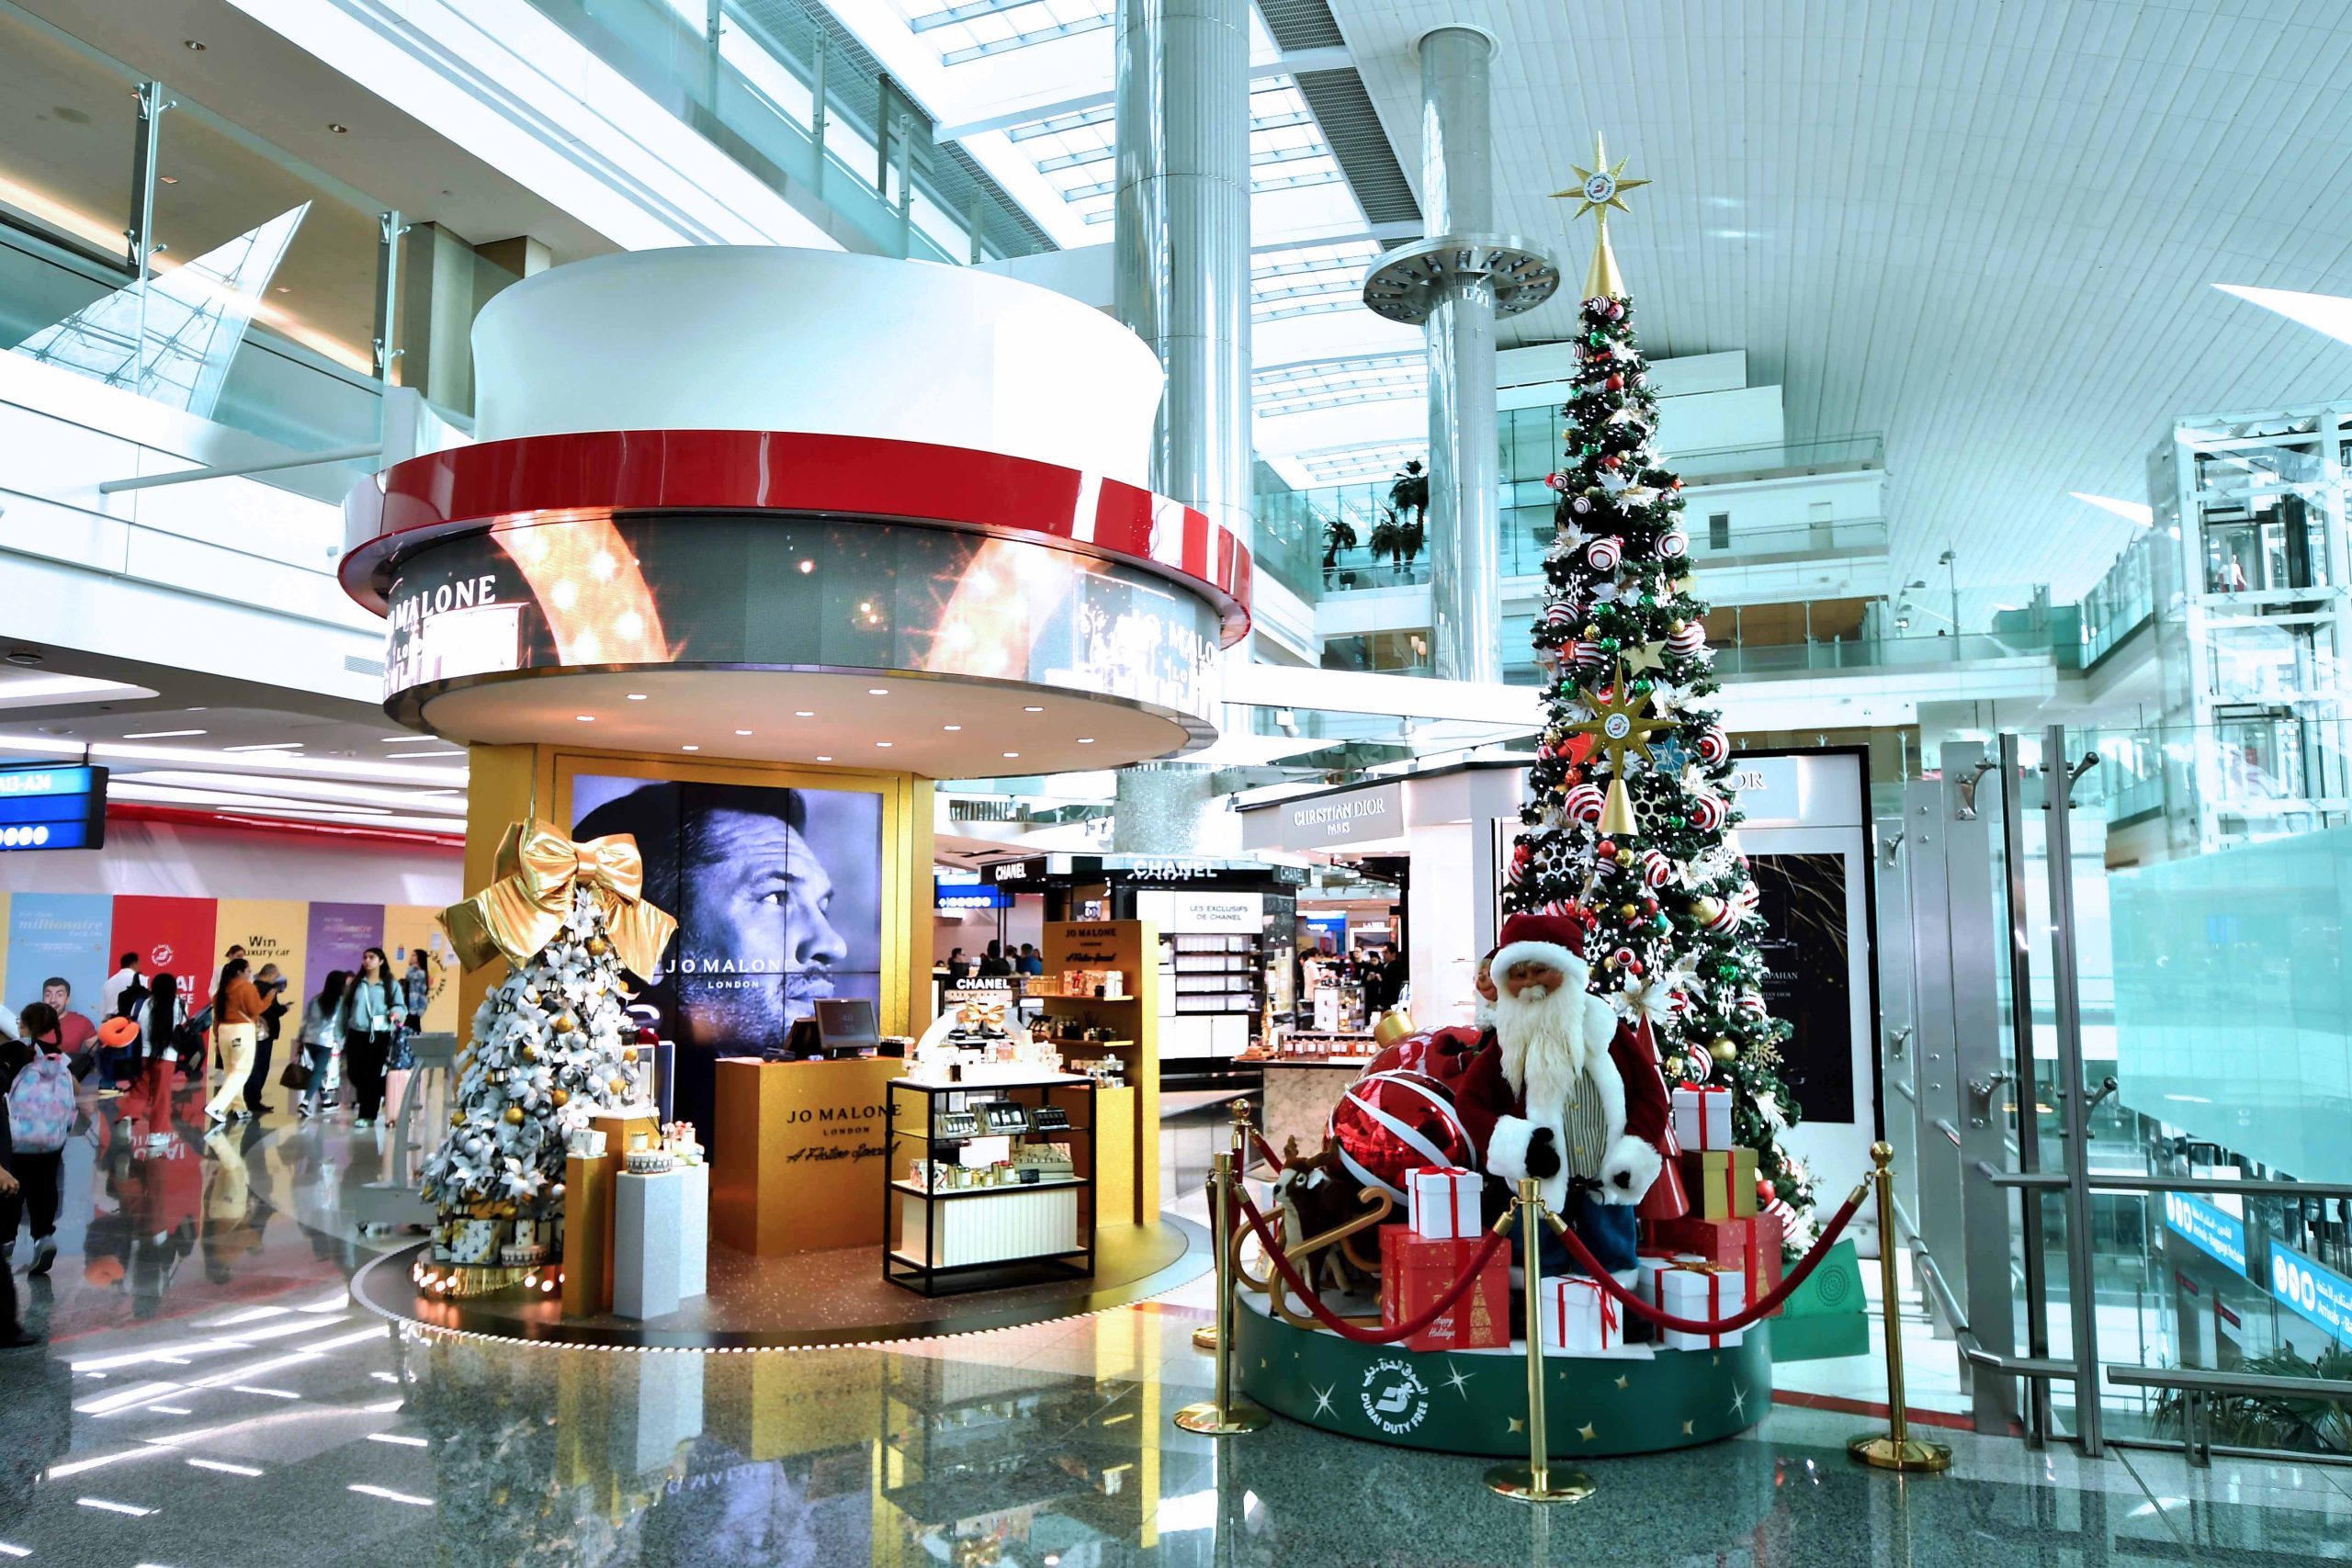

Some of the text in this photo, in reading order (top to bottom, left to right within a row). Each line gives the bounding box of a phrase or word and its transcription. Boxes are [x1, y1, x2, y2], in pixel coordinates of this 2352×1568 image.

[394, 575, 496, 632] MALONE
[1294, 797, 1385, 827] CHRISTIAN DIOR
[1327, 821, 1351, 836] PARIS
[995, 863, 1027, 882] CHANEL
[1133, 860, 1217, 878] CHANEL
[1280, 866, 1306, 883] CHANEL
[1066, 928, 1117, 938] JO MALONE
[249, 935, 277, 947] Win
[243, 949, 274, 958] uxury
[665, 960, 696, 974] JO
[707, 981, 760, 990] LONDON
[956, 978, 1012, 990] CHANEL
[786, 1109, 813, 1124] JO
[823, 1126, 871, 1137] LONDON
[1429, 1327, 1455, 1341] Holidays
[1361, 1392, 1429, 1435] DUBAI DUTY FREE
